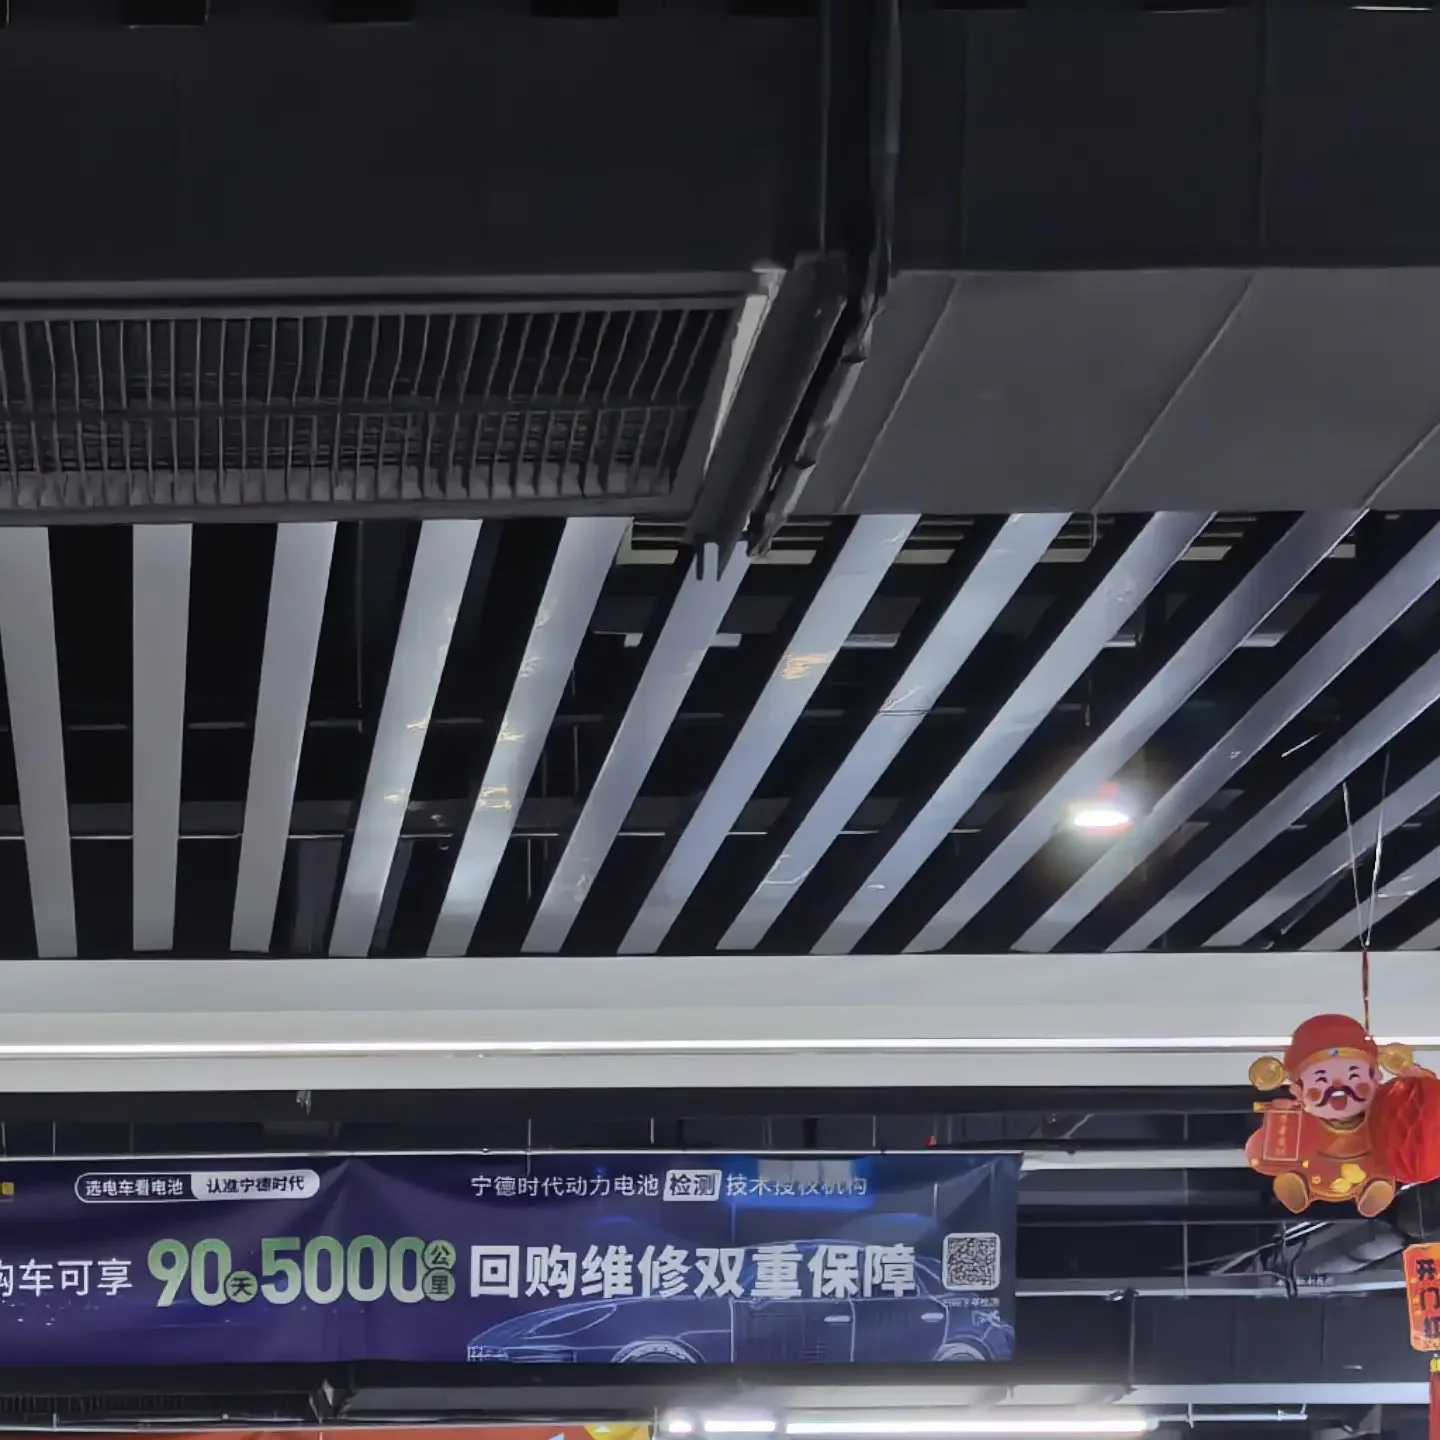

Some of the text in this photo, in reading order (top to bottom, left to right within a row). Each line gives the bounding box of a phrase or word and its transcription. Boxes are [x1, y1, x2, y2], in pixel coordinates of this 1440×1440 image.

[469, 1173, 660, 1198] 宁德时代动力电池
[669, 1172, 716, 1198] 检测
[469, 1243, 917, 1300] 回购维修双重保障
